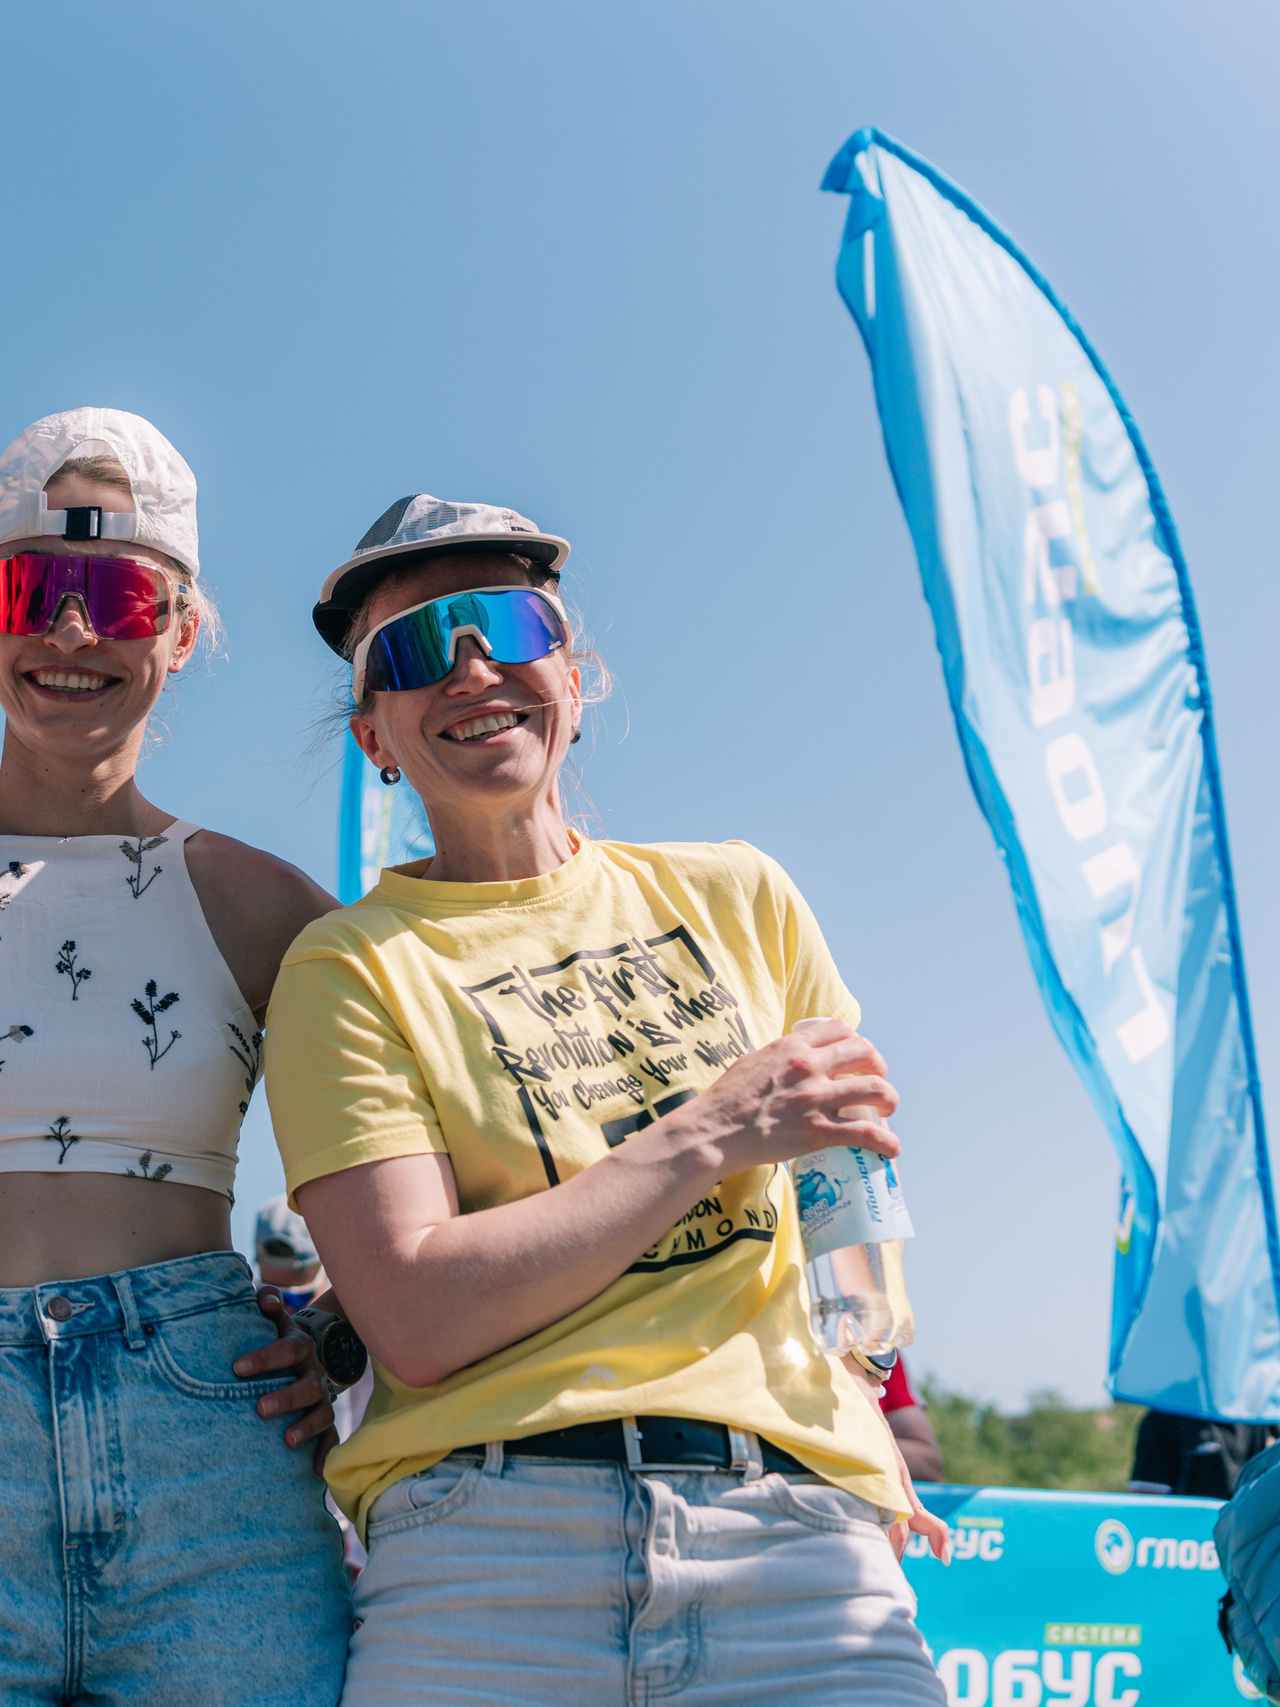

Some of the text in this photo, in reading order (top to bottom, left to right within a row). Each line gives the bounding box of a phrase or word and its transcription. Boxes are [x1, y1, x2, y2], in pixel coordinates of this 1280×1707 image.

[640, 1053, 687, 1087] Your
[1136, 1537, 1220, 1571] ГЛОБ
[936, 1648, 1142, 1707] ОБУС
